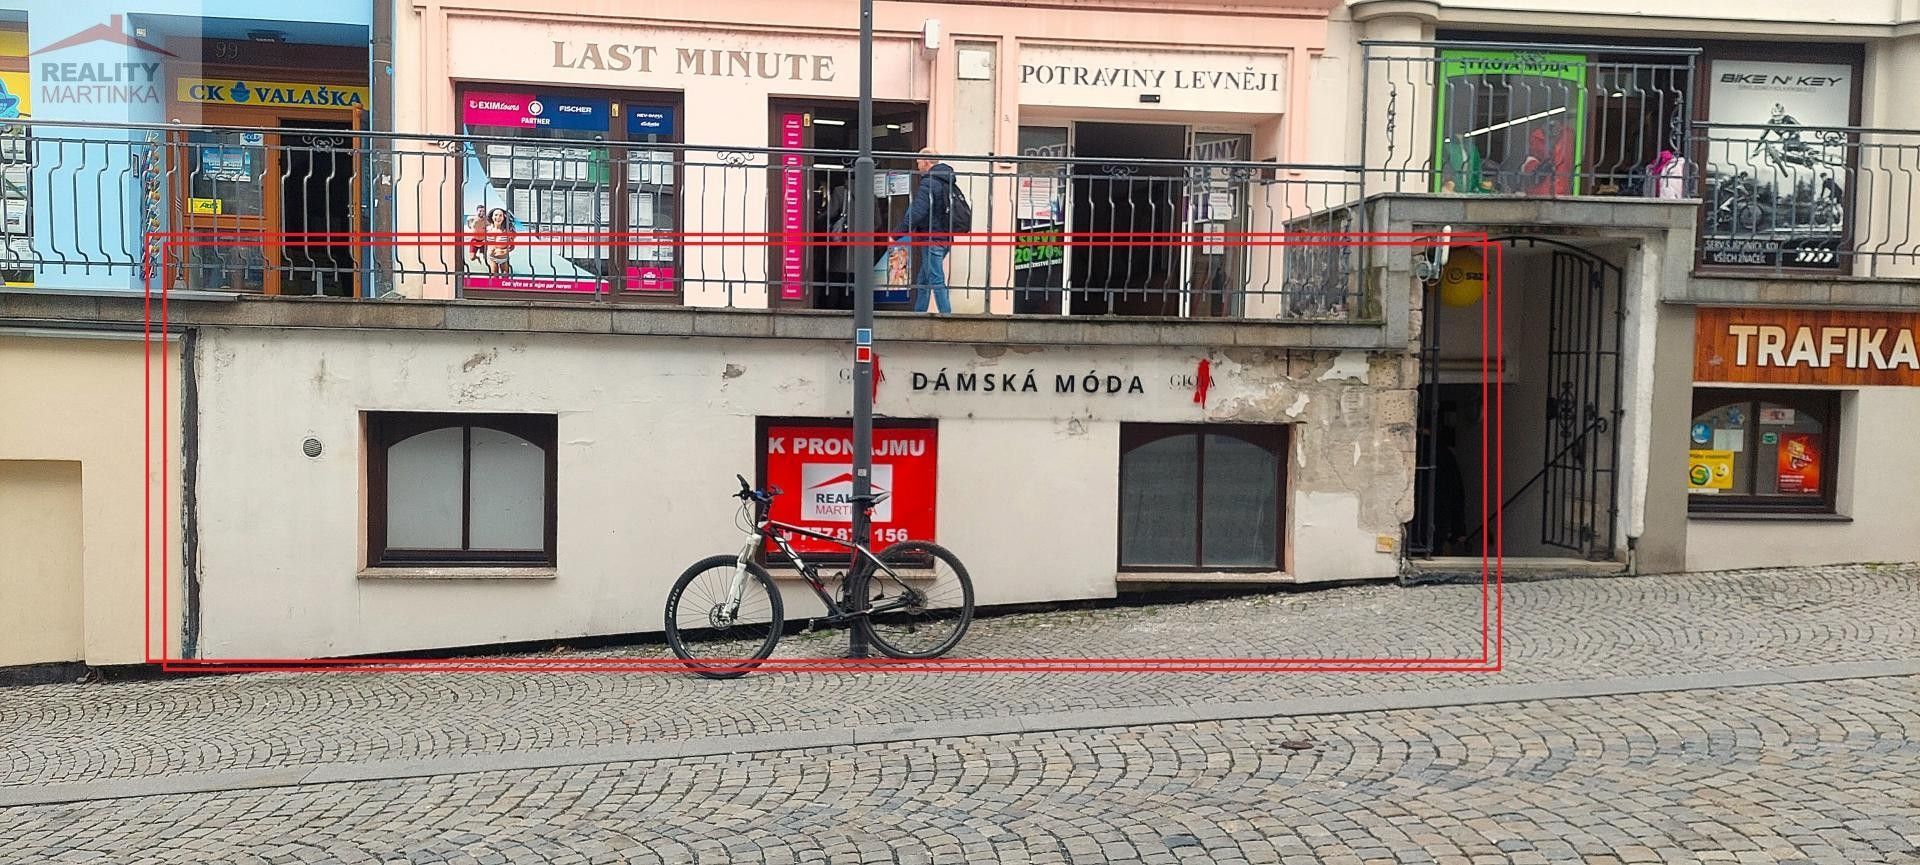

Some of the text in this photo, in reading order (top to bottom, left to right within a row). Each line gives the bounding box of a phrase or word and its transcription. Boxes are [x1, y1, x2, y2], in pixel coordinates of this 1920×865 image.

[216, 41, 240, 58] 99
[552, 41, 836, 82] LAST MINUTE
[1019, 65, 1279, 91] POTRAVINY LEVNĚJI
[1721, 73, 1767, 84] BIKE
[1796, 76, 1843, 87] KEY
[189, 85, 361, 106] CK VALAŠKA
[559, 105, 592, 113] FISCHER
[521, 116, 551, 125] PARTNER
[1729, 325, 1919, 370] TRAFIKA
[912, 368, 1038, 392] DÁMSKÁ
[1055, 370, 1144, 393] MÓDA
[768, 437, 925, 456] K PRONJMU
